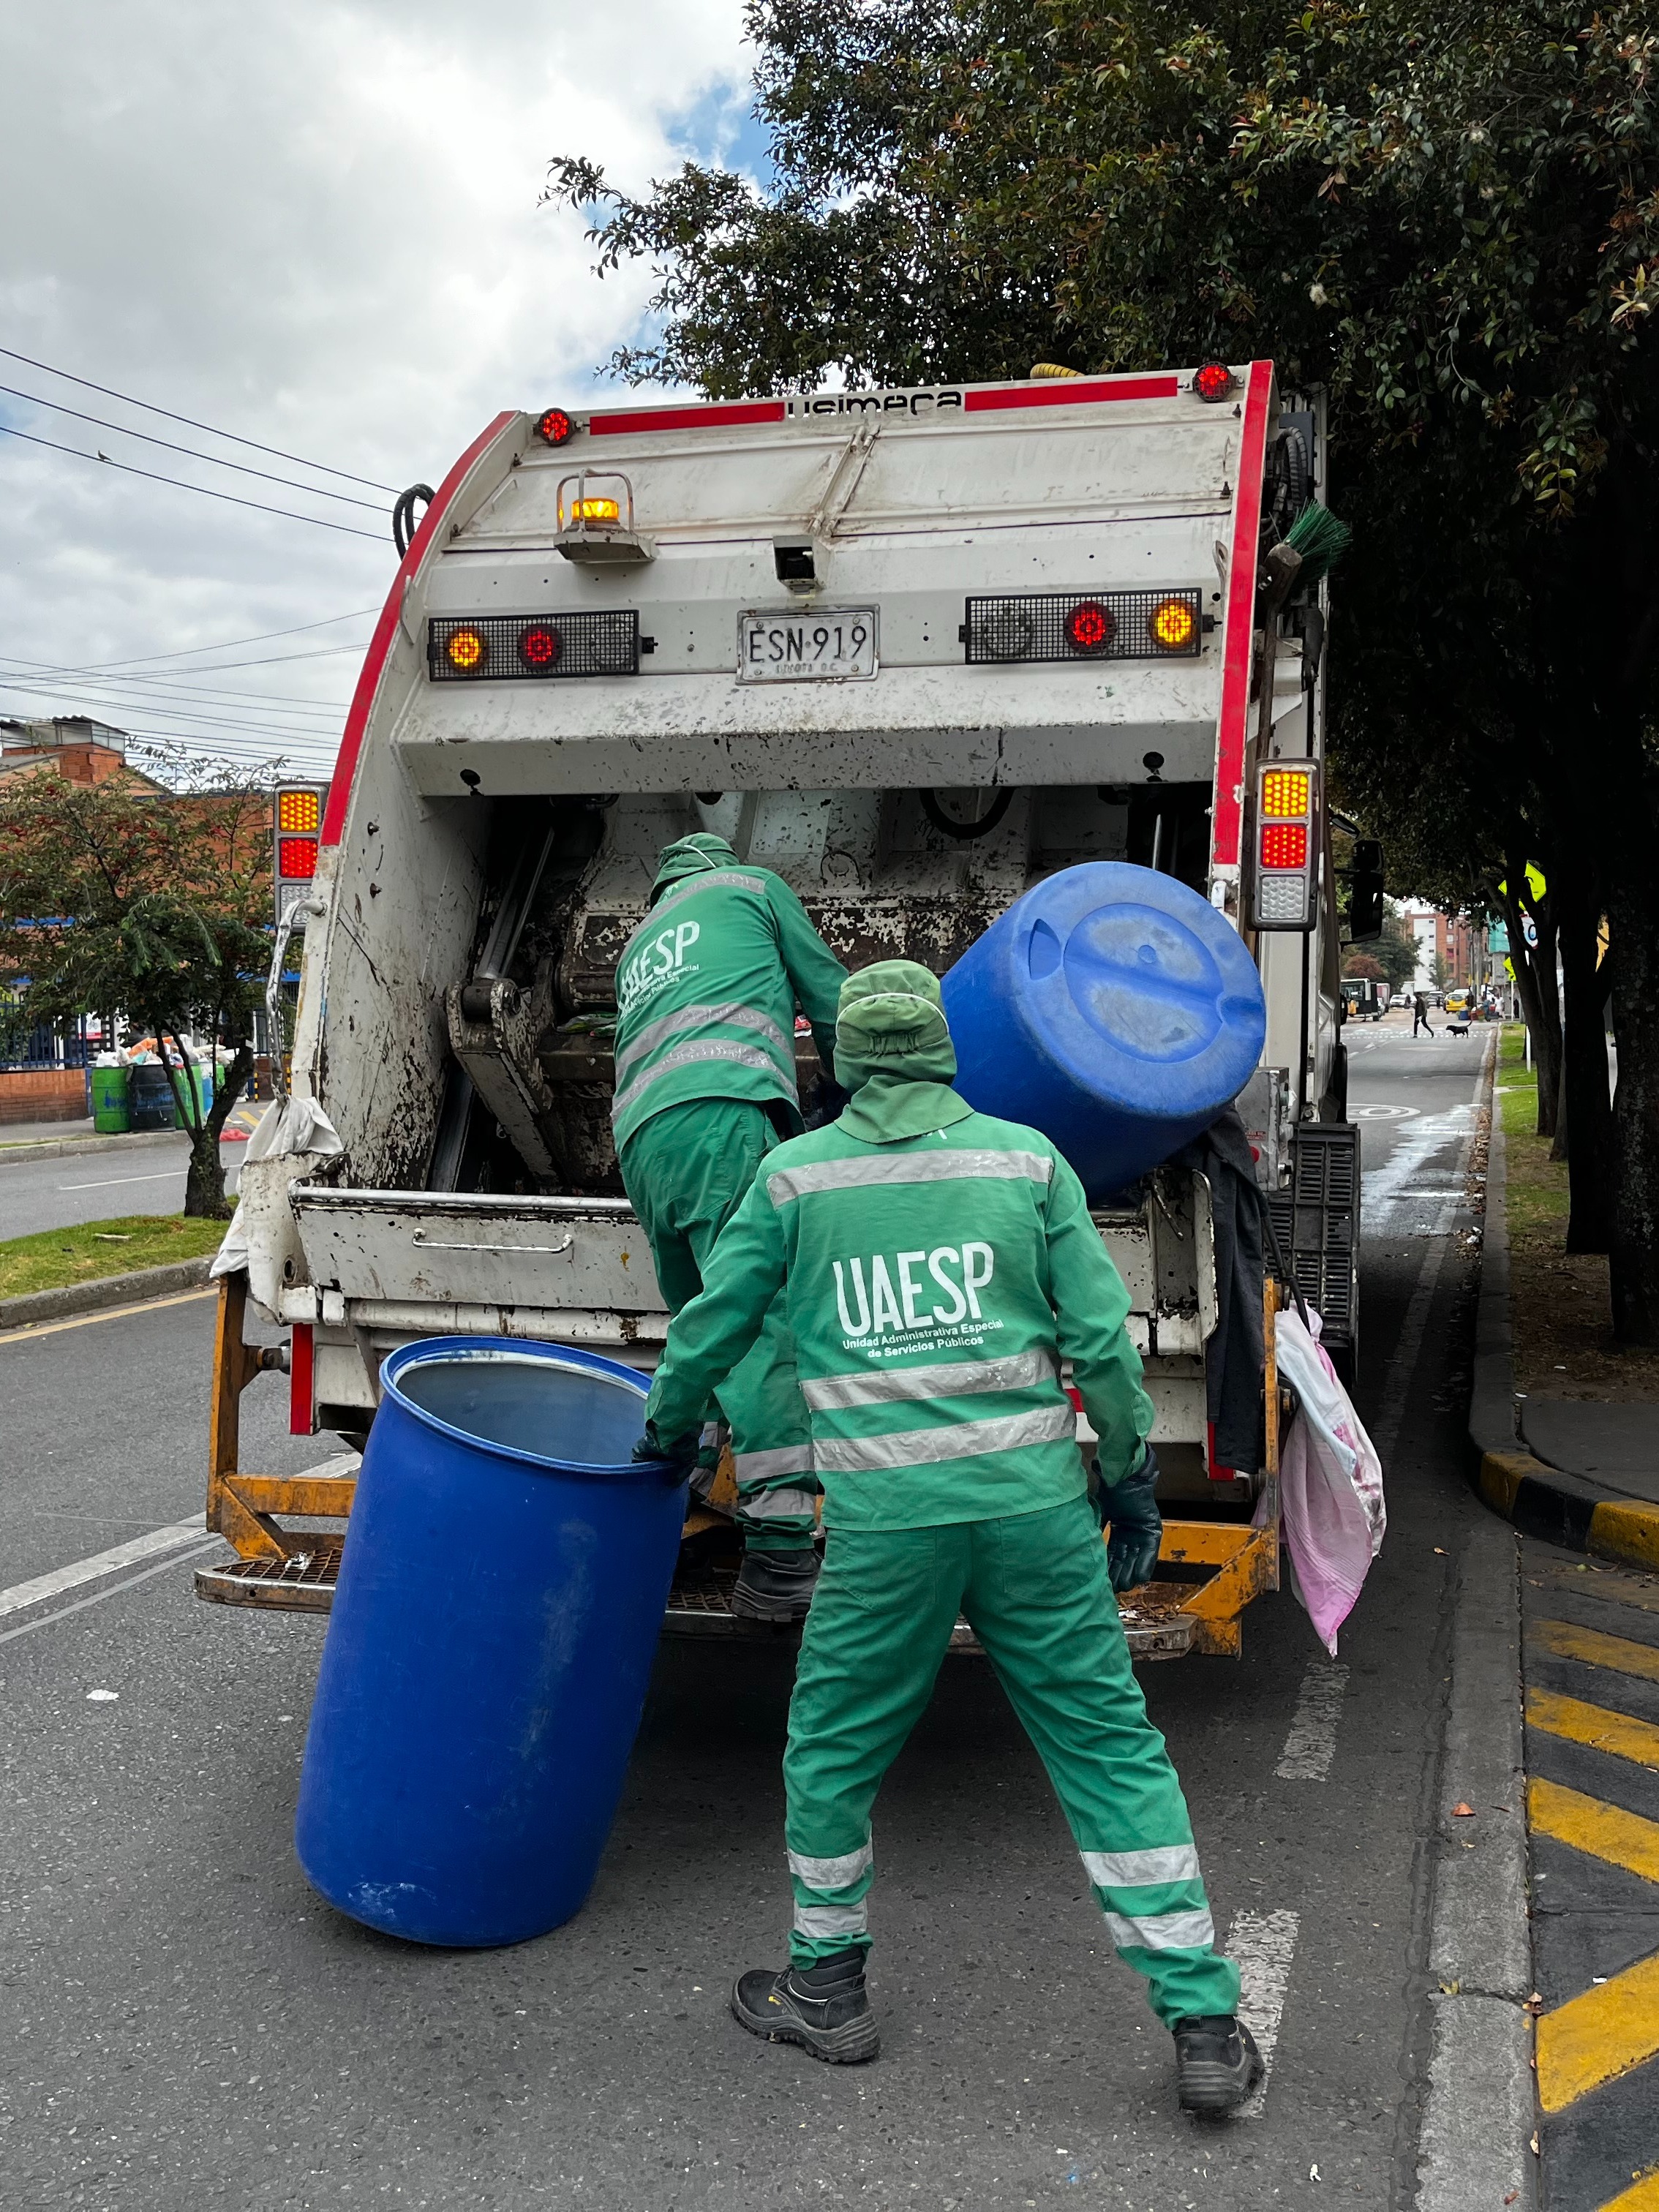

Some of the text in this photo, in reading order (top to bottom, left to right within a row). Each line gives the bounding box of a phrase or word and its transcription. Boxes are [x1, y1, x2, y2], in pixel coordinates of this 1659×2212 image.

[788, 391, 961, 419] usimeca
[832, 1241, 993, 1337] UAESP
[843, 1319, 1004, 1350] Unidad Administrativa Especial
[868, 1336, 984, 1358] de Servicios Públicos
